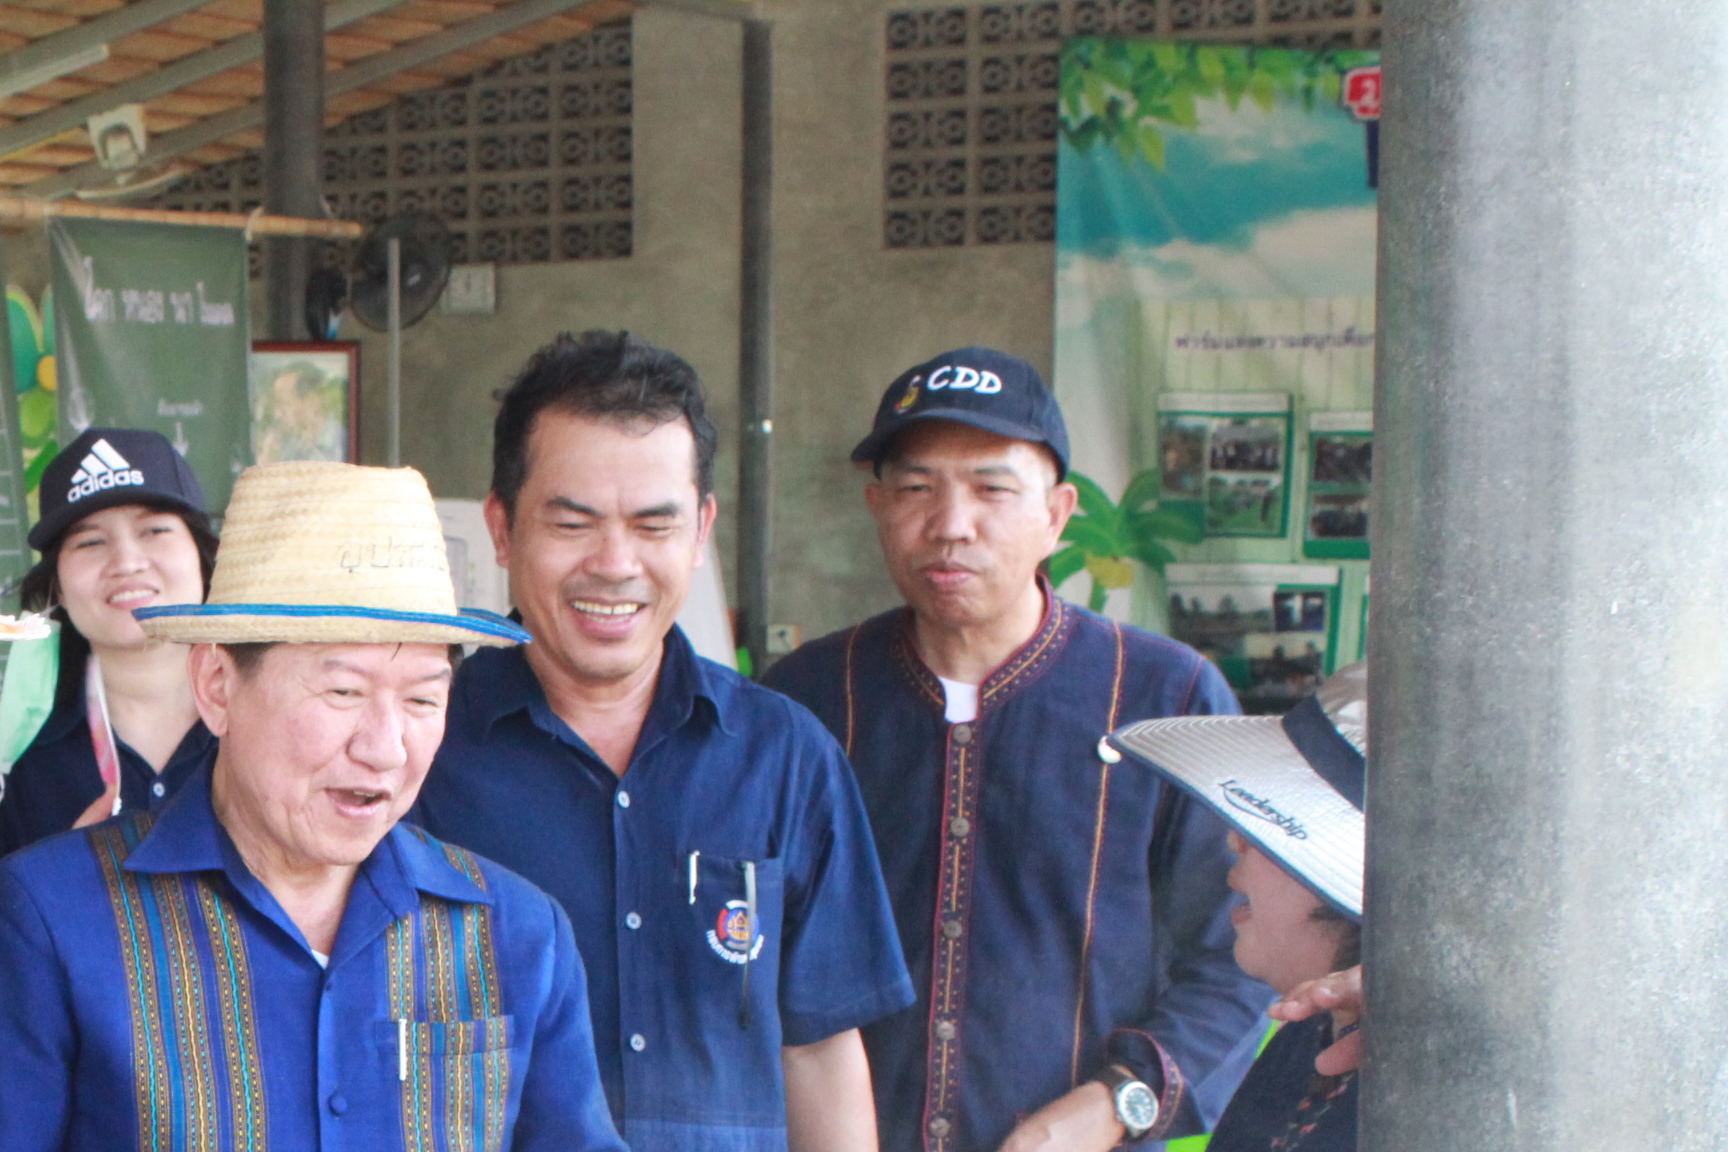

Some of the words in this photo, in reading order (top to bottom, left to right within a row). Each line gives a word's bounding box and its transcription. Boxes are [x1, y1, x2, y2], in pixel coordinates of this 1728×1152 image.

[927, 365, 1003, 395] CDD
[67, 469, 144, 503] adidas
[1218, 779, 1308, 840] Leadership
